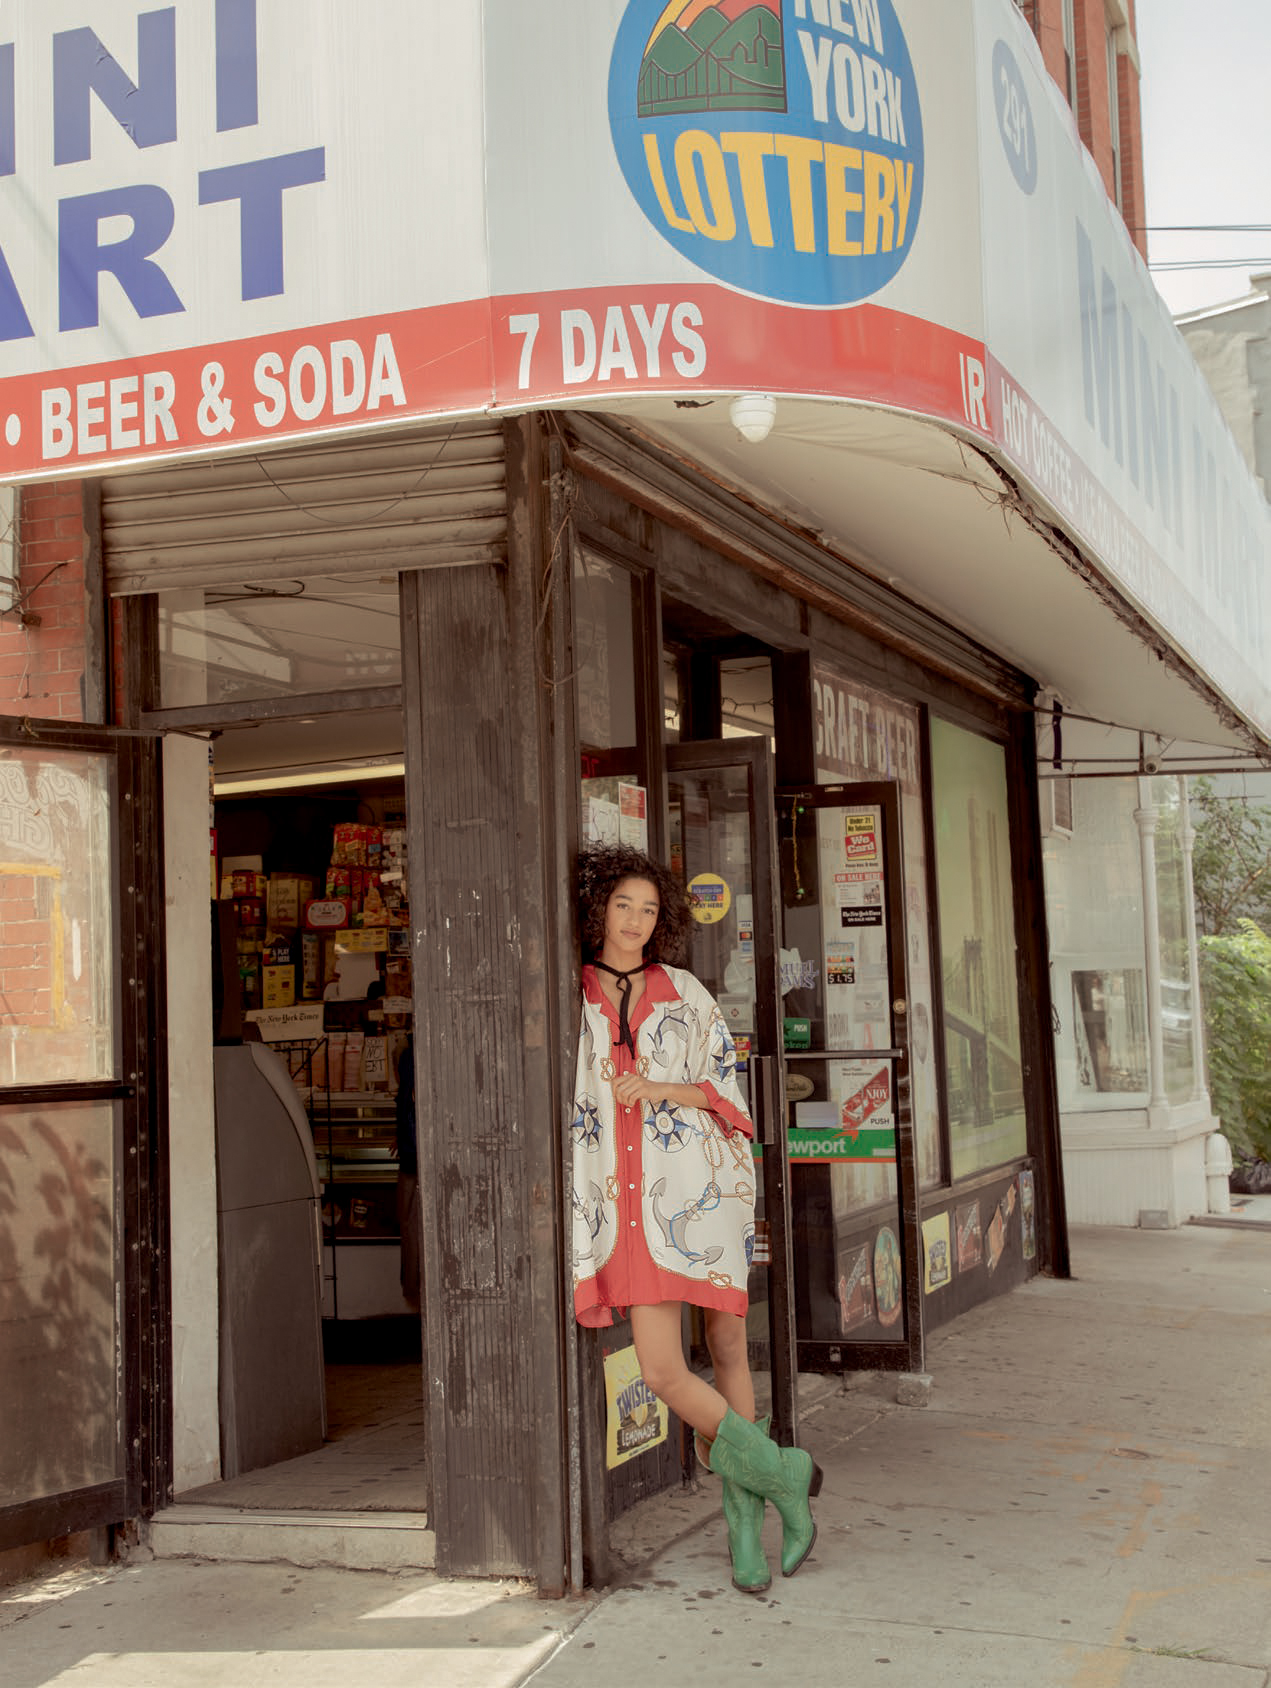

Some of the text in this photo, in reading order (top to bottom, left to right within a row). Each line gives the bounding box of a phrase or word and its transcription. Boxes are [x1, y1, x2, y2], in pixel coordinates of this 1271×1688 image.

[797, 30, 907, 147] YORK
[1000, 64, 1031, 175] 291
[642, 130, 914, 257] LOTTERY
[41, 332, 408, 460] BEER & SODA
[509, 302, 707, 390] 7 DAYS
[1001, 377, 1028, 464] HOT
[1031, 412, 1073, 514] COFFEE
[813, 678, 870, 769] CRAFT
[847, 841, 874, 854] Card
[850, 835, 870, 845] We
[787, 1137, 847, 1157] ewport
